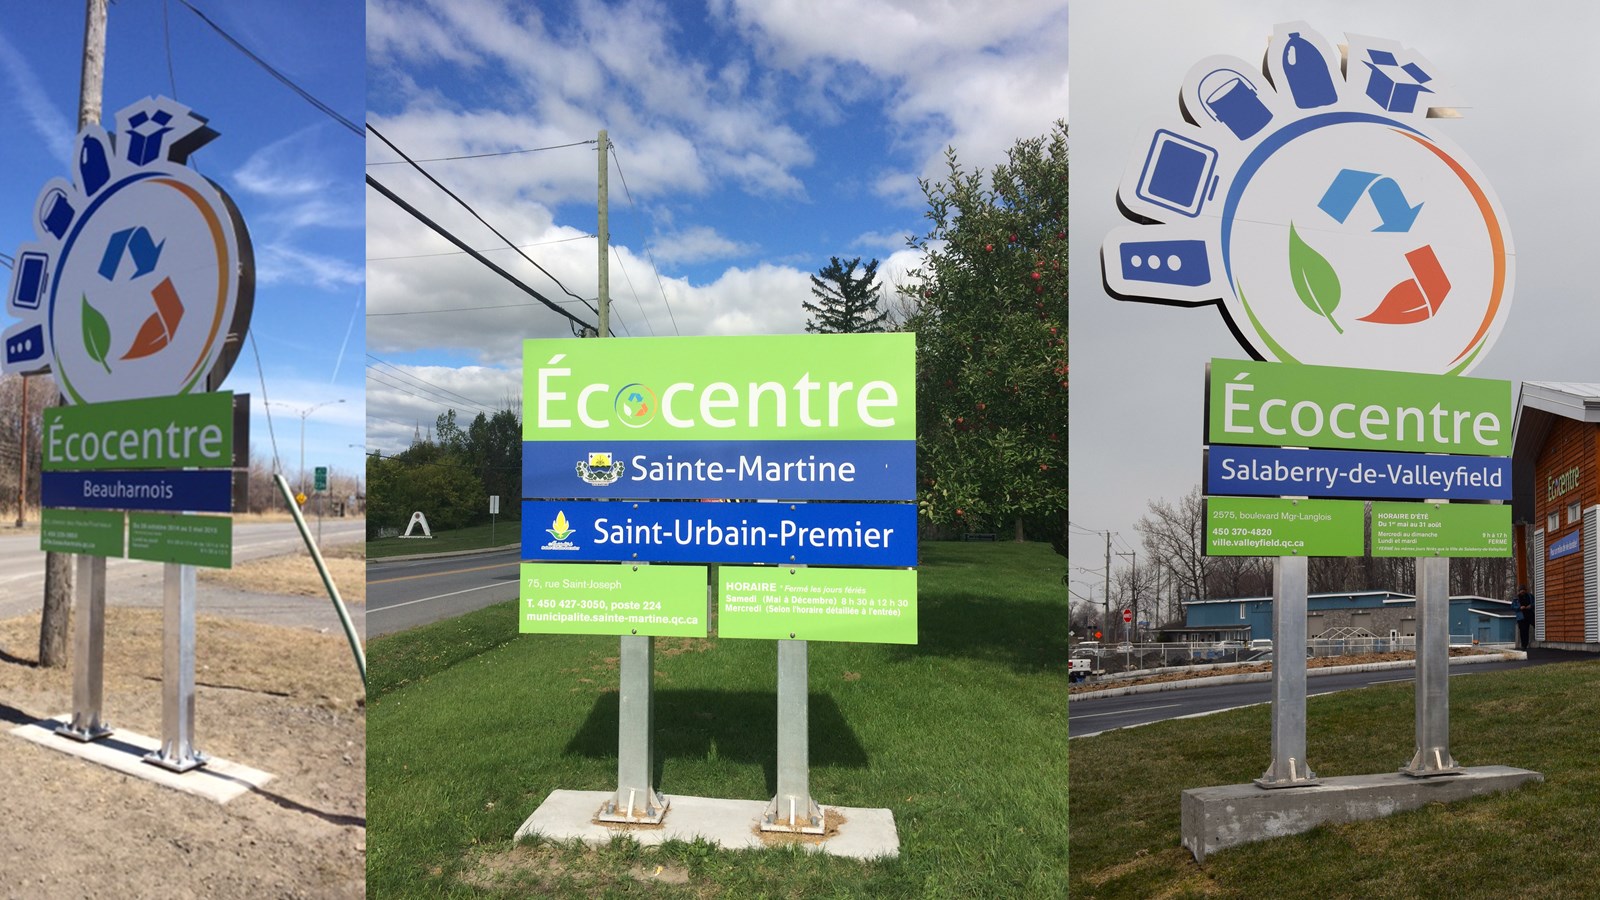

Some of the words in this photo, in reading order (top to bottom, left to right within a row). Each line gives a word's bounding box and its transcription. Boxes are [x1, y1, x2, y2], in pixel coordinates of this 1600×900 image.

[1224, 372, 1500, 446] Écocentre
[48, 416, 222, 462] Écocentre
[631, 455, 856, 482] Sainte-Martine
[1221, 458, 1502, 491] Salaberry-de-Valleyfield
[83, 480, 173, 499] Beauharnois
[1213, 511, 1238, 520] 2575,
[1240, 512, 1279, 520] boulevard
[1281, 512, 1332, 522] Mgr-Langlois
[593, 518, 894, 548] Saint-Urbain-Premier
[1212, 528, 1229, 536] 450
[1231, 528, 1272, 536] 370-4820
[1212, 539, 1304, 548] ville.valleyfield.qc.ca
[527, 579, 543, 589] 75,
[562, 579, 622, 591] Saint-Joseph
[726, 582, 777, 592] HORAIRE
[784, 585, 808, 593] Fermé
[810, 585, 821, 593] les
[823, 585, 843, 594] jours
[844, 586, 866, 594] fériés
[527, 599, 535, 608] T.
[537, 600, 556, 608] 450
[558, 600, 608, 610] 427-3050,
[611, 601, 640, 611] poste
[643, 601, 661, 610] 224
[726, 595, 757, 603] Samedi
[784, 596, 789, 604] à
[791, 596, 837, 605] Décembre)
[857, 598, 867, 606] 30
[870, 598, 874, 606] à
[898, 599, 908, 607] 30
[725, 604, 762, 613] Mercredi
[766, 605, 790, 614] (Selon
[792, 606, 823, 614] l'horaire
[826, 606, 859, 615] détaillée
[862, 607, 866, 615] à
[527, 612, 698, 625] municipalite.sainte-martine.qc.ca
